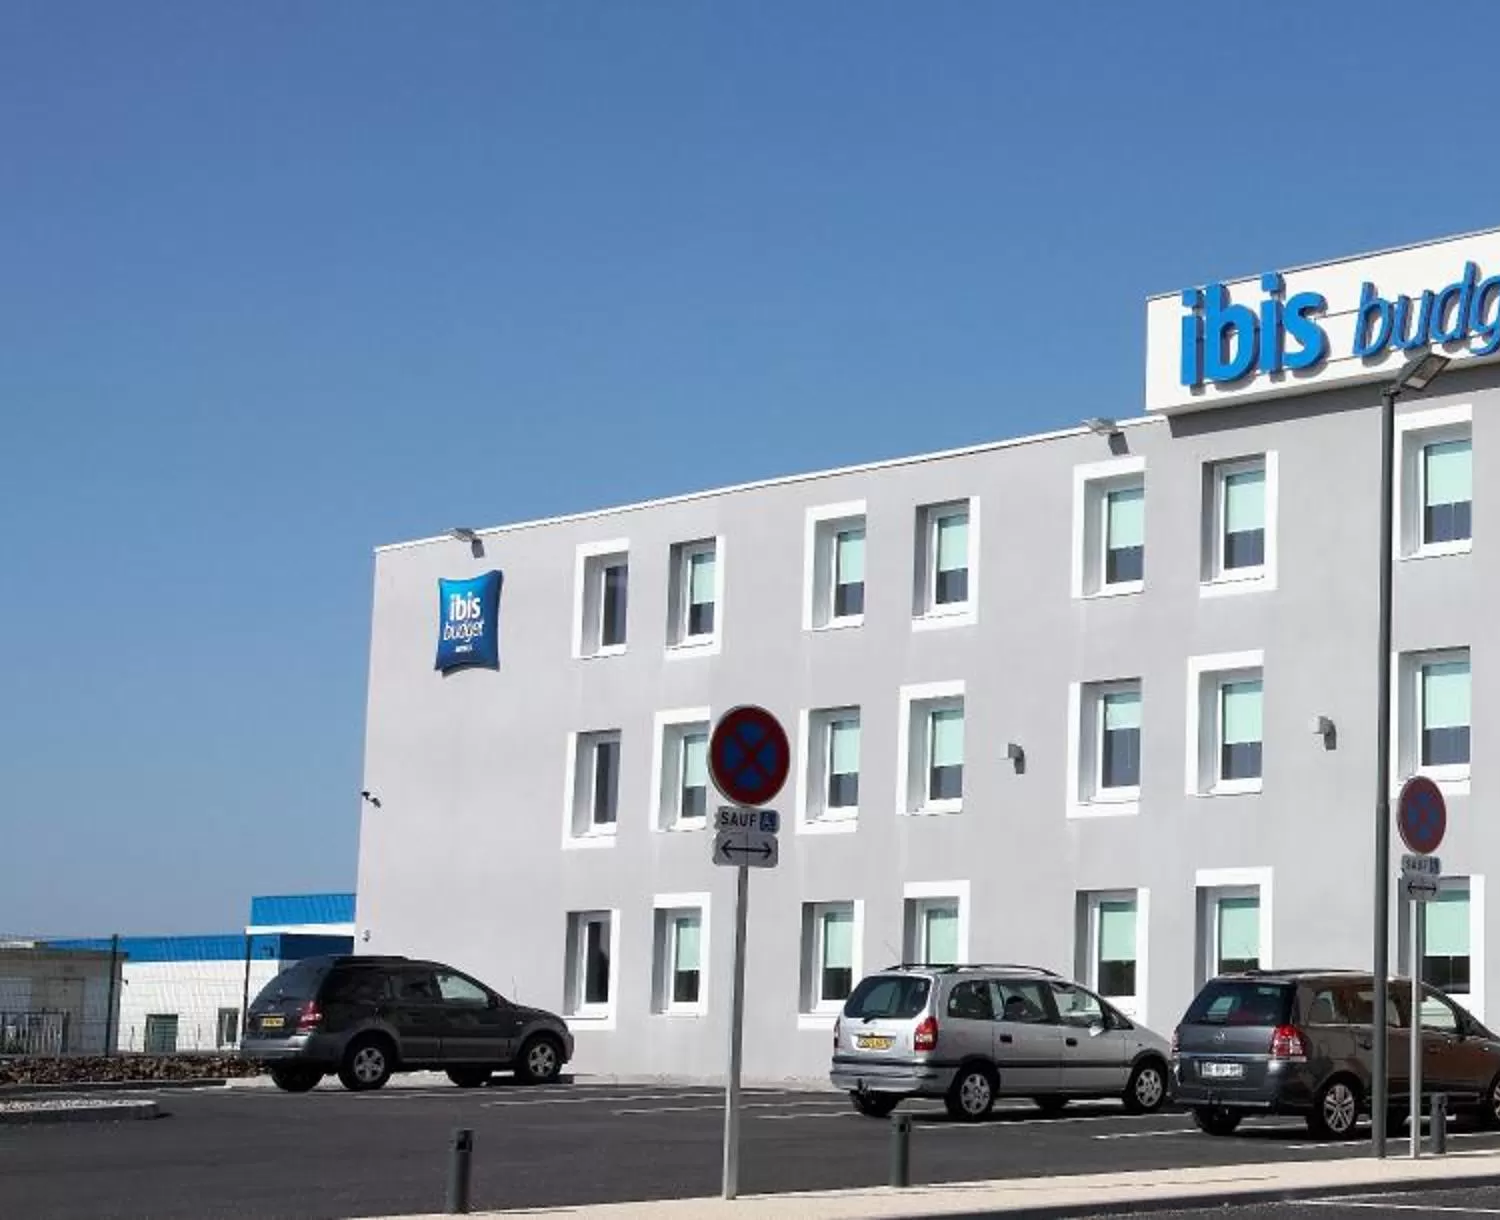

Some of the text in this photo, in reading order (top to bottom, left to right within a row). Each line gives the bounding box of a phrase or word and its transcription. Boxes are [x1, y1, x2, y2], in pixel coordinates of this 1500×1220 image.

[1180, 272, 1329, 388] ibis
[449, 591, 481, 621] ibis
[443, 620, 485, 643] budget
[720, 811, 757, 828] SAUF
